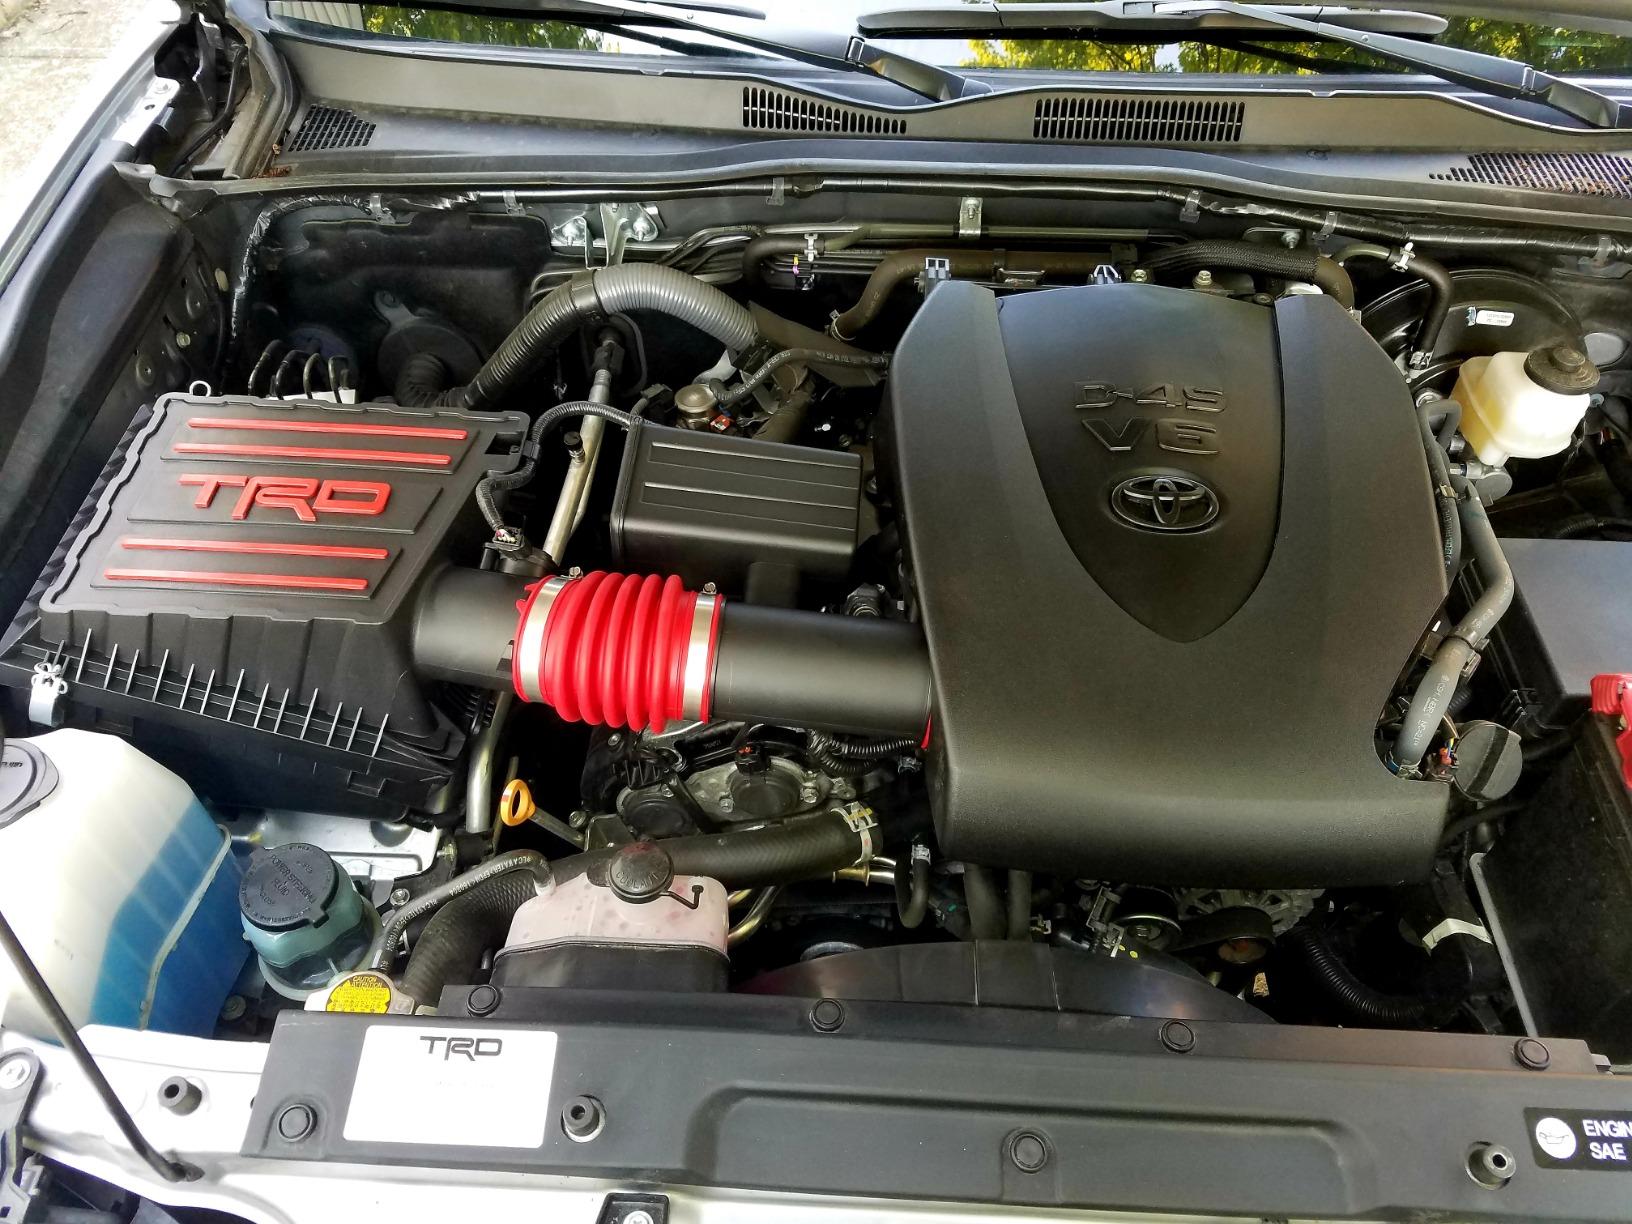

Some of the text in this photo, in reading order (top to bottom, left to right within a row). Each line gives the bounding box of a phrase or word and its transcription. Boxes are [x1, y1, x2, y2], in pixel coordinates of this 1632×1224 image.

[1074, 380, 1227, 414] D-4S
[1082, 416, 1221, 455] V6
[178, 473, 393, 522] TRD
[419, 1035, 503, 1062] TRD
[1589, 1141, 1627, 1161] SAE
